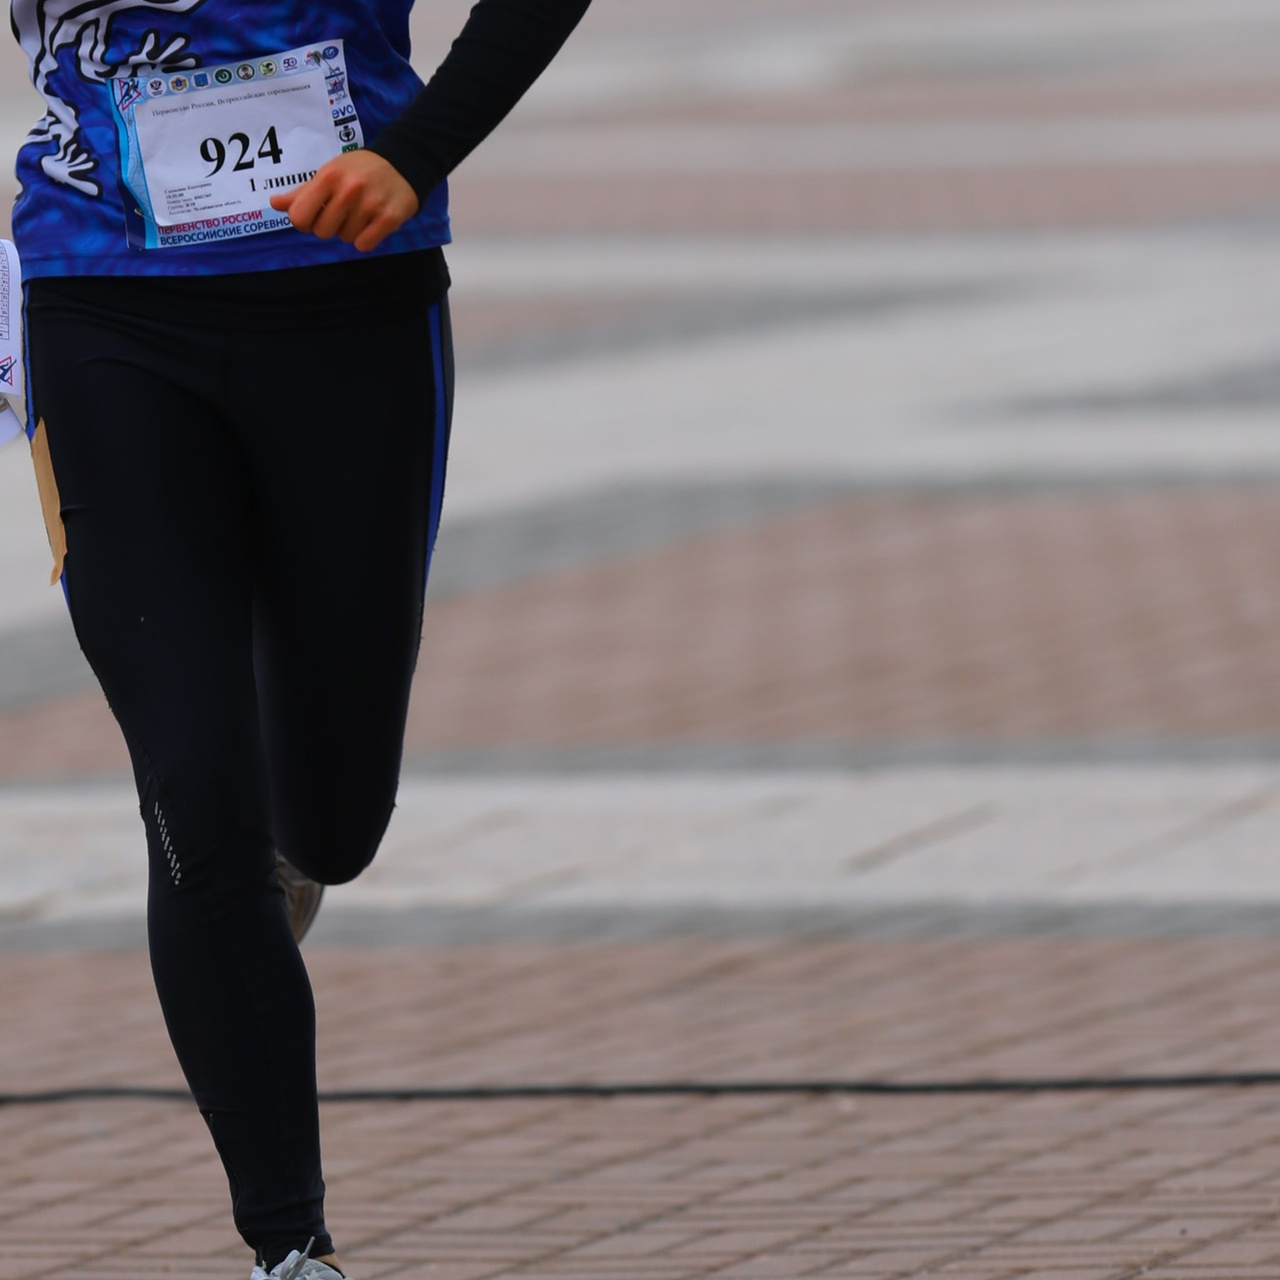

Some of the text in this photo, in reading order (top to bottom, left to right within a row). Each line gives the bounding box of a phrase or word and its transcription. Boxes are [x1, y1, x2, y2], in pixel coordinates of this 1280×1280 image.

[199, 125, 284, 178] 924
[249, 177, 256, 192] 1
[157, 210, 263, 235] ПЕРВЕНСТВО РОССИИ
